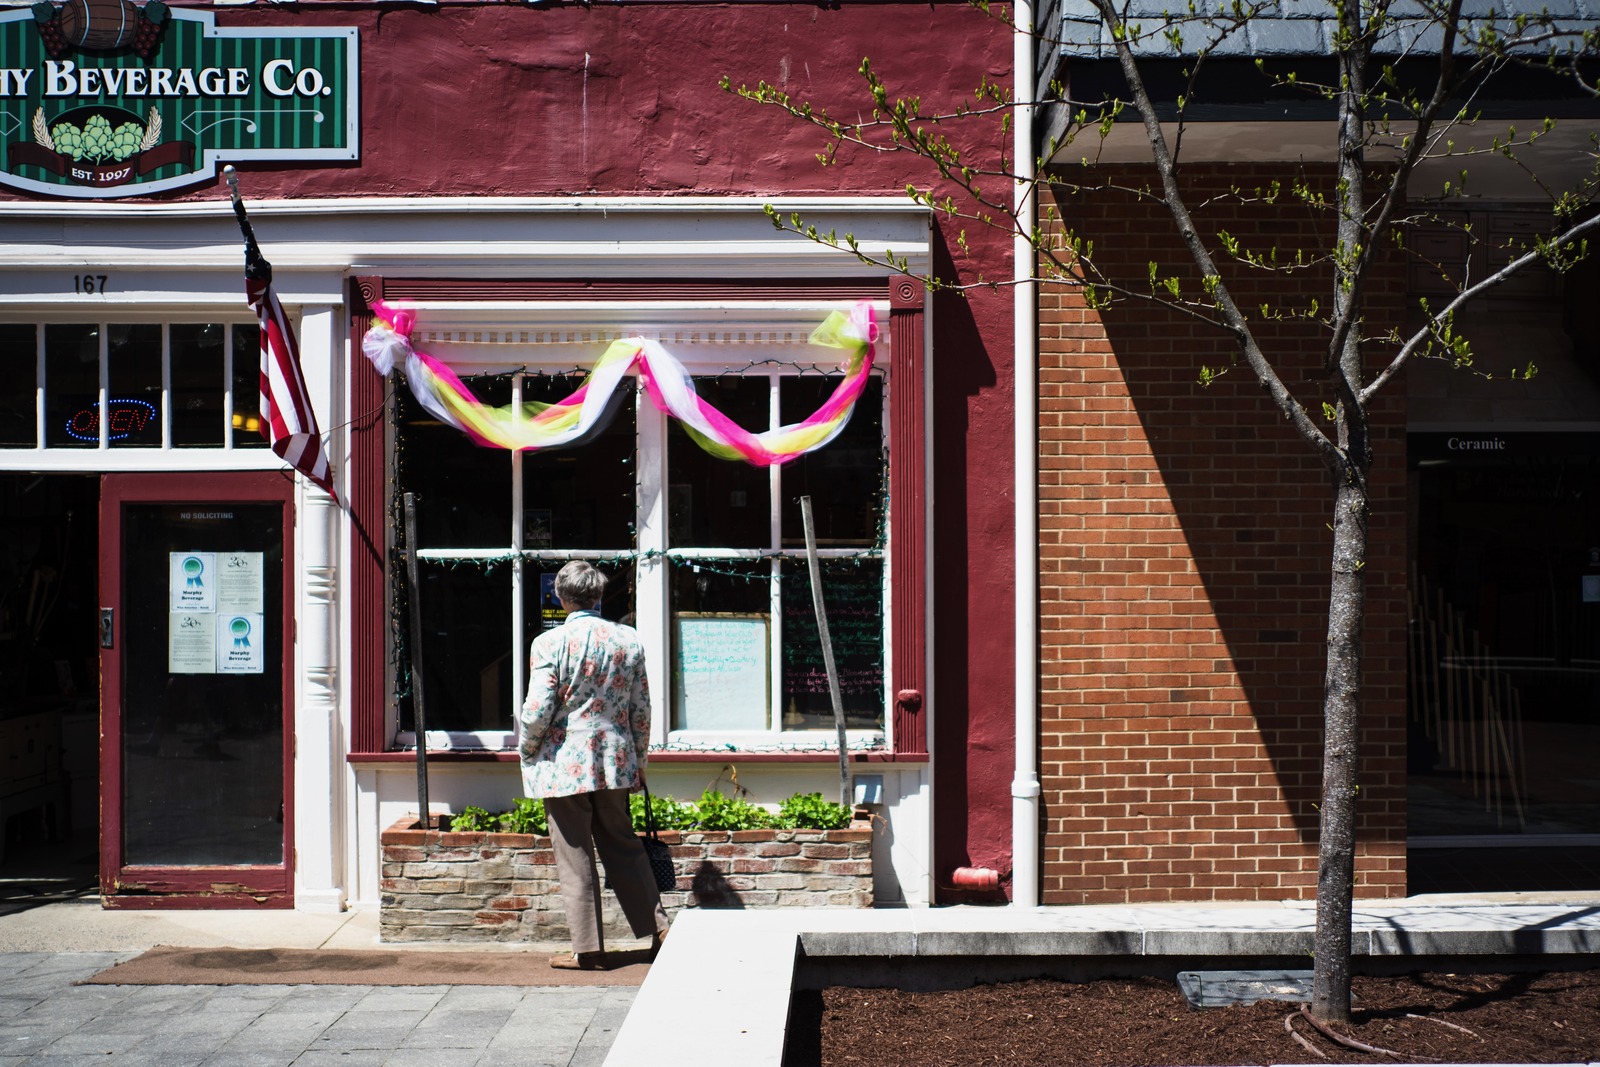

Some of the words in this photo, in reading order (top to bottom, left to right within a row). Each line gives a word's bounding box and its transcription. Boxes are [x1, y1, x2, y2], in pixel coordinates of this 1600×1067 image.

[71, 167, 95, 181] EST.
[99, 167, 131, 181] 1997
[74, 275, 108, 295] 167
[72, 408, 150, 432] OPEN
[1447, 437, 1506, 450] Ceramic
